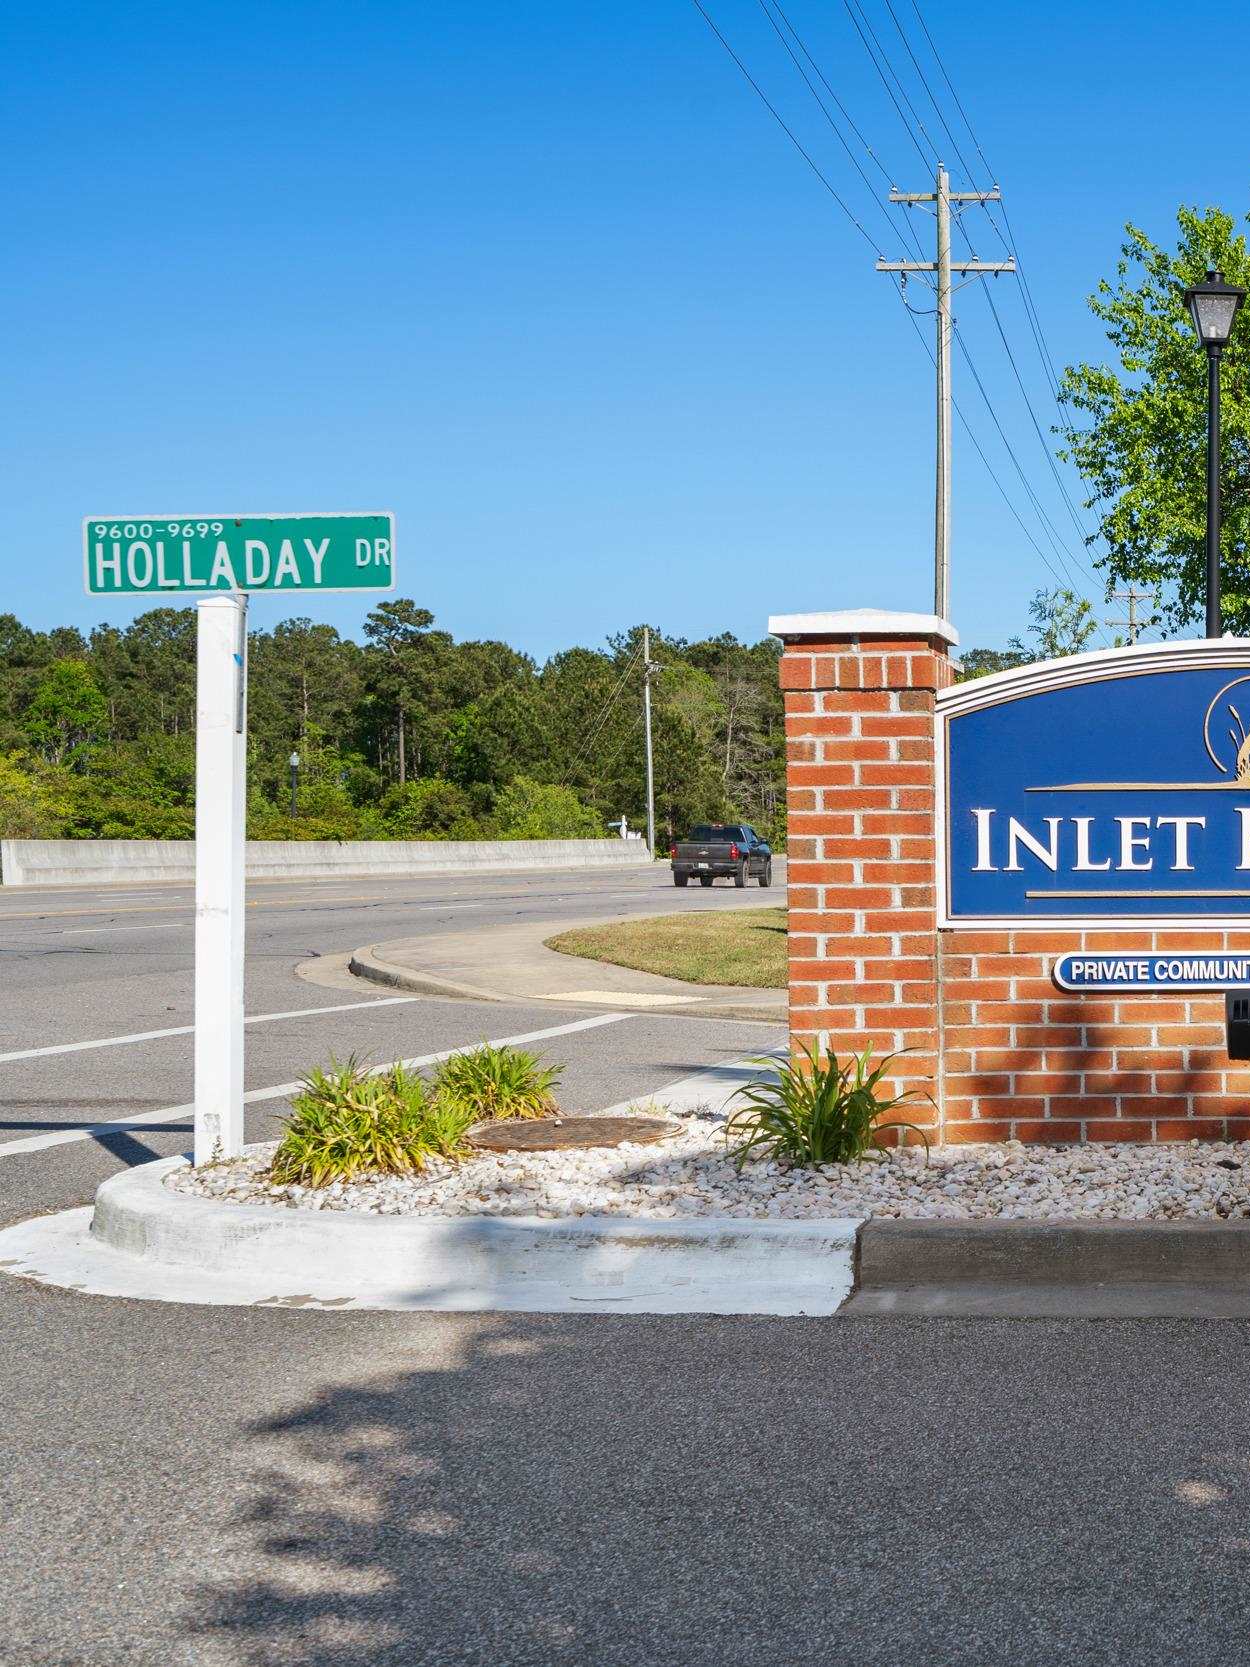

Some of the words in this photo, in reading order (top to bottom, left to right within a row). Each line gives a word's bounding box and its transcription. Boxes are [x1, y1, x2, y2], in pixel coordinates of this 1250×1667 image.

[95, 522, 224, 539] 9600-9699
[95, 538, 331, 588] HOLLADAY
[355, 538, 391, 567] DR
[1071, 960, 1150, 980] PRIVATE
